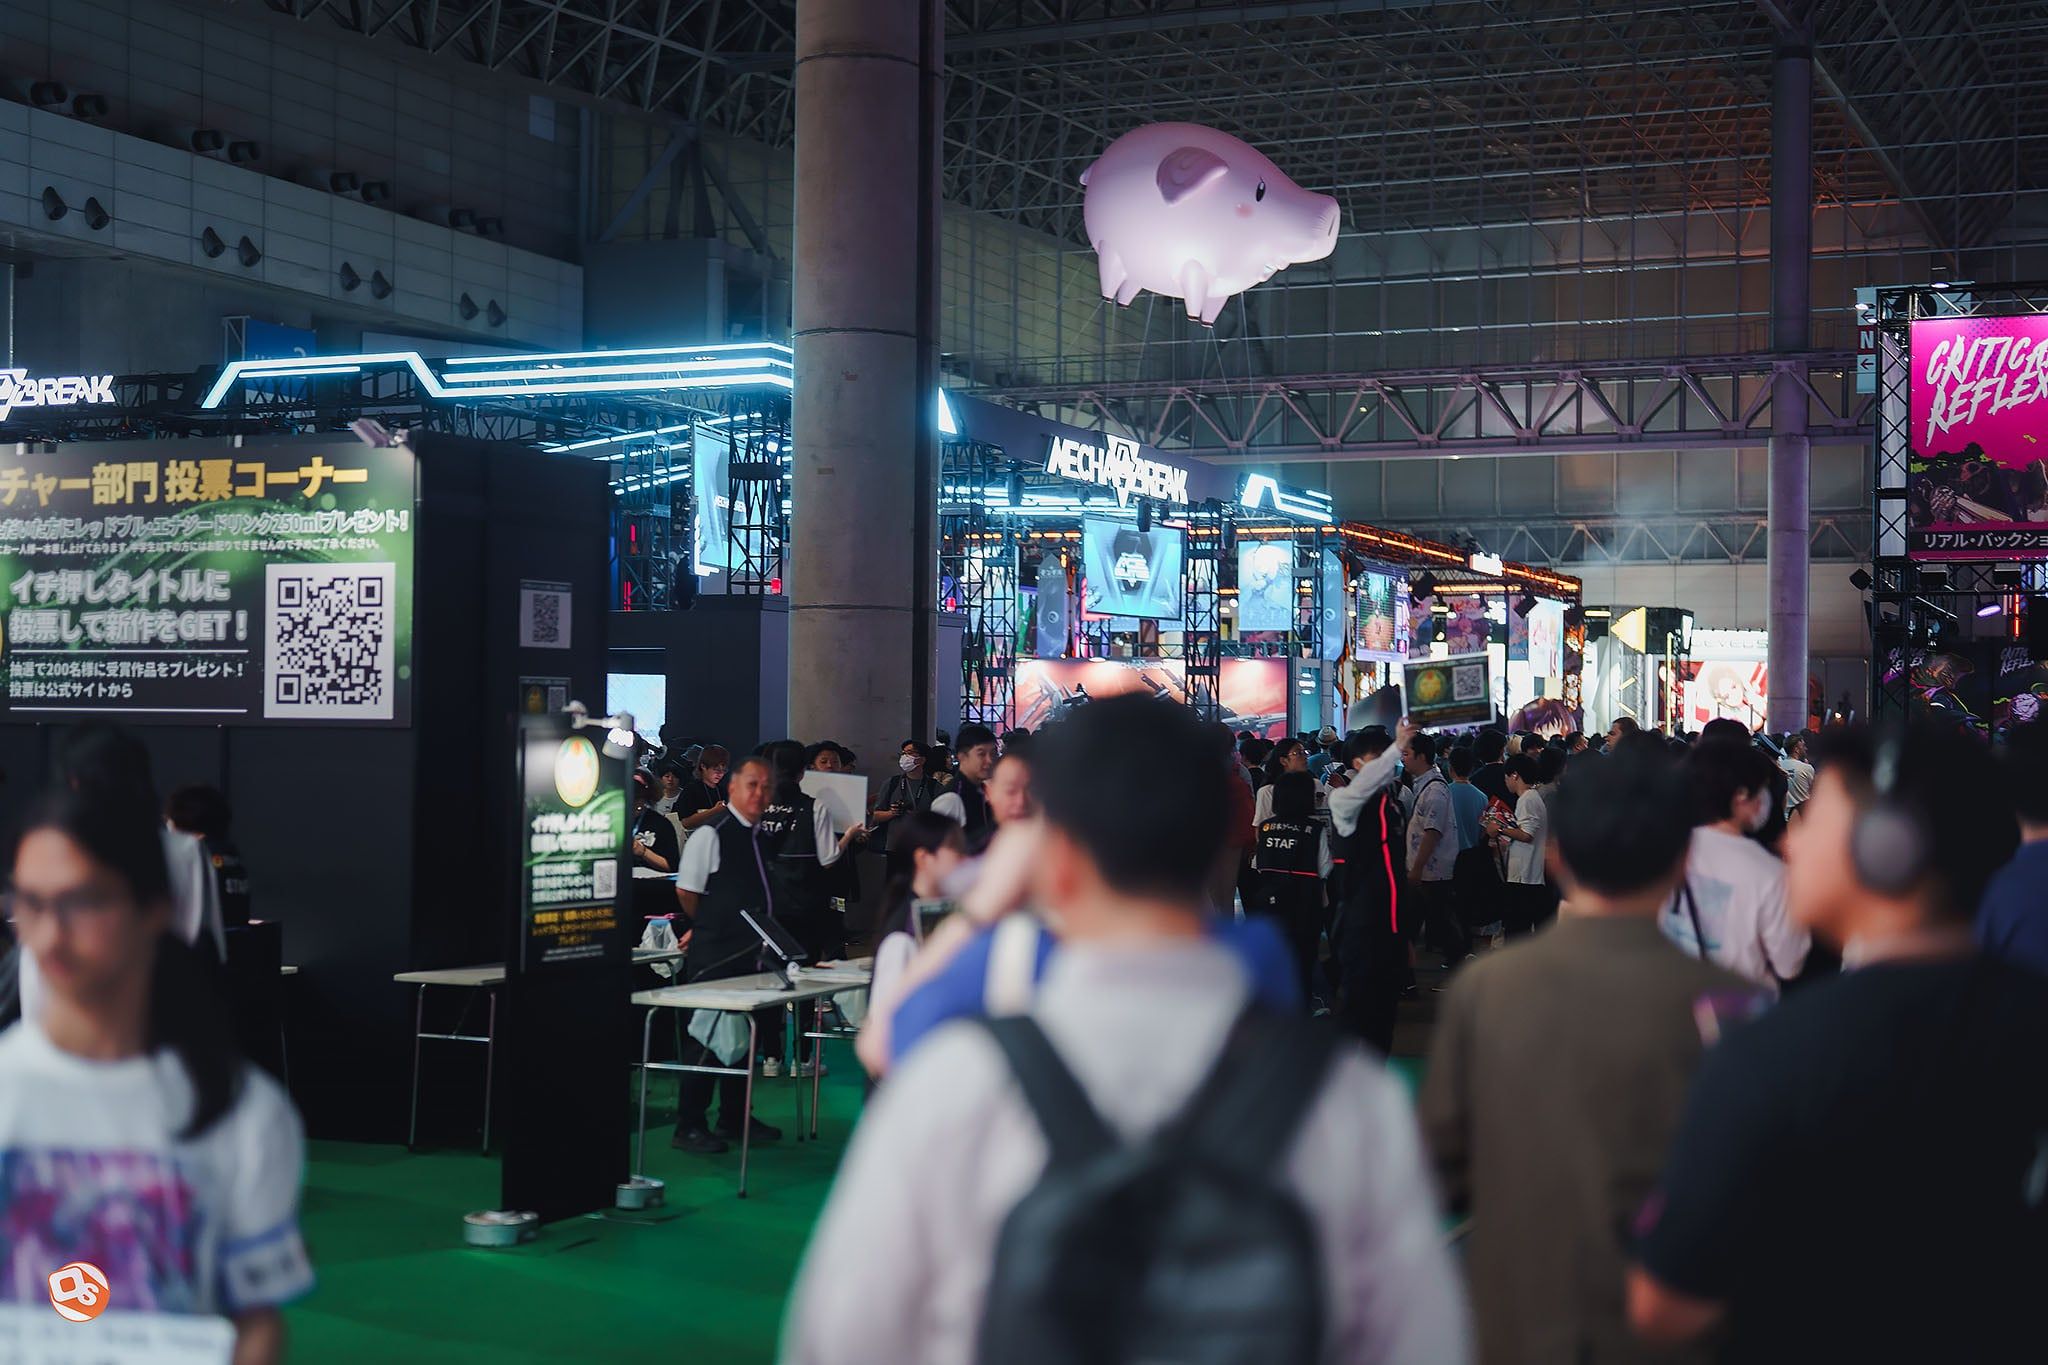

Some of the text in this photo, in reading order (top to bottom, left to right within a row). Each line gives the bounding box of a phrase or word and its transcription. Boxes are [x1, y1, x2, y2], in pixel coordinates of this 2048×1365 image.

[1860, 330, 1874, 349] N
[164, 456, 368, 503] 投票コーナー
[10, 568, 231, 604] イチ押しタイトルに
[9, 682, 134, 699] 投票は公式サイトから
[1266, 837, 1298, 849] STAF
